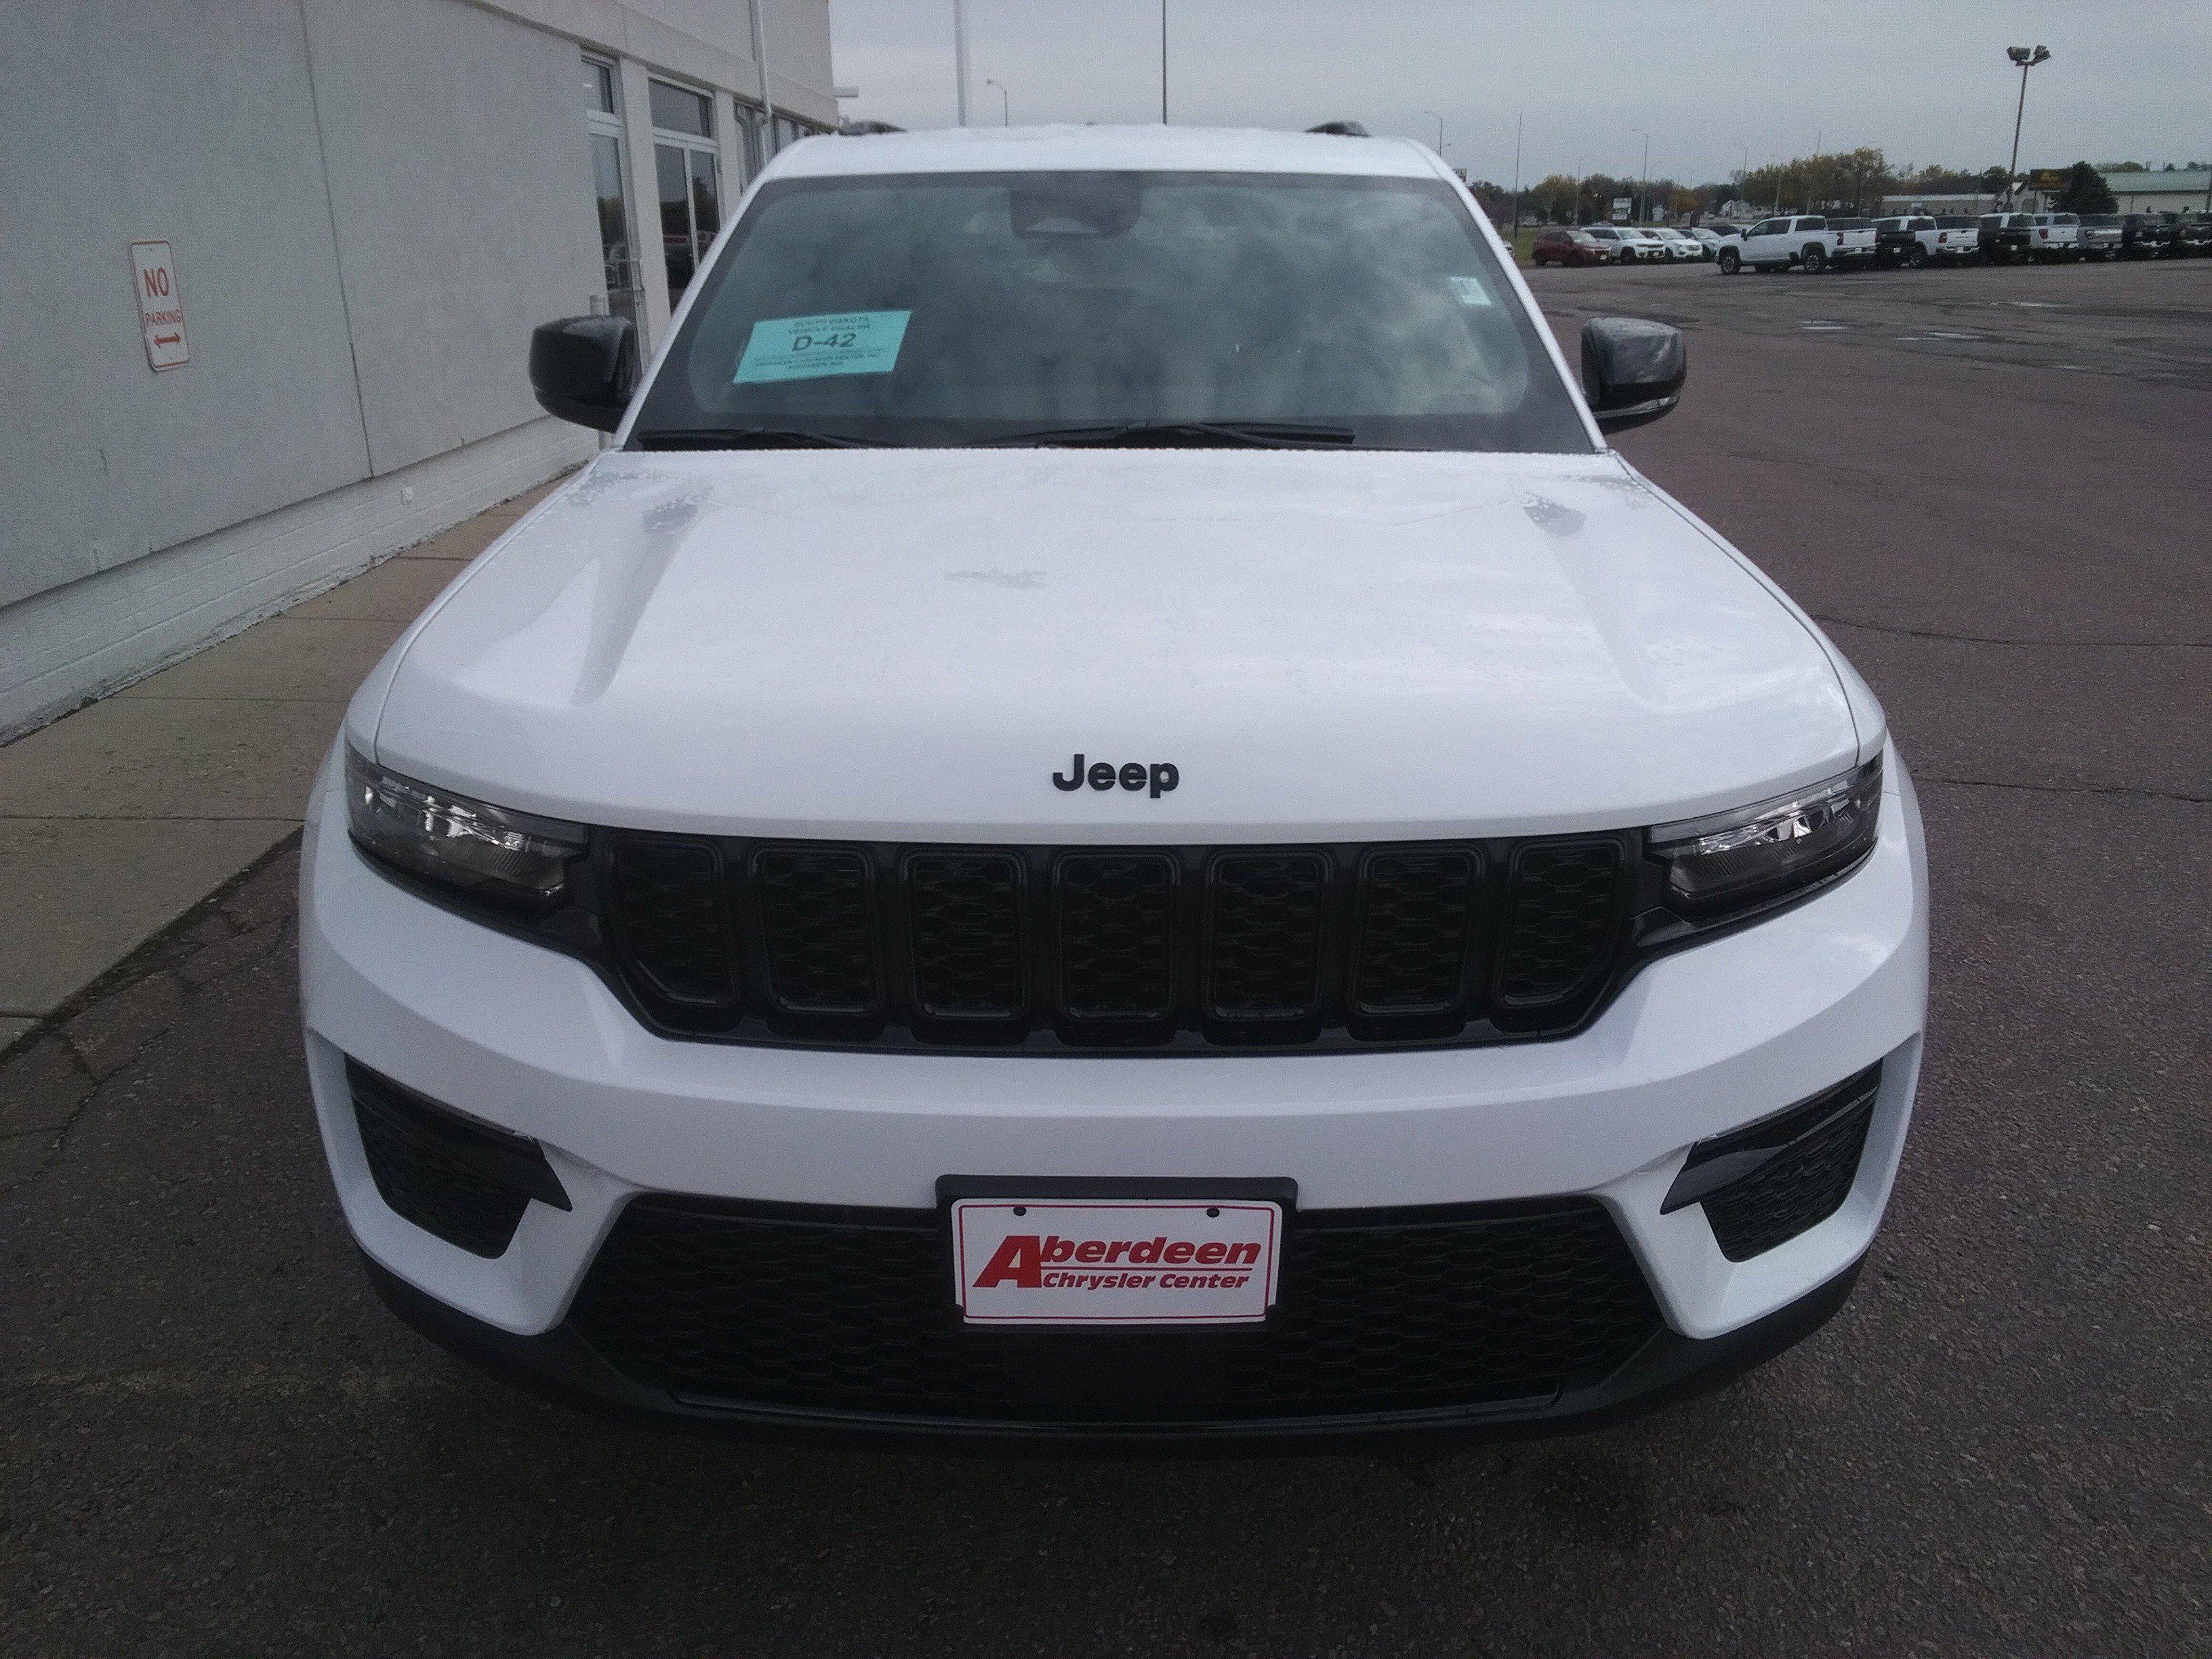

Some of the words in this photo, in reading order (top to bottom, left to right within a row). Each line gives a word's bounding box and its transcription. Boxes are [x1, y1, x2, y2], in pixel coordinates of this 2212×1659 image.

[144, 267, 169, 298] NO
[144, 310, 181, 326] PARKING
[829, 316, 869, 325] DAKOTA
[792, 333, 857, 351] D-42
[1052, 754, 1179, 799] Jeep
[972, 1235, 1262, 1288] Aberdeen
[1042, 1272, 1156, 1291] Chrysler
[1159, 1272, 1250, 1289] Center
